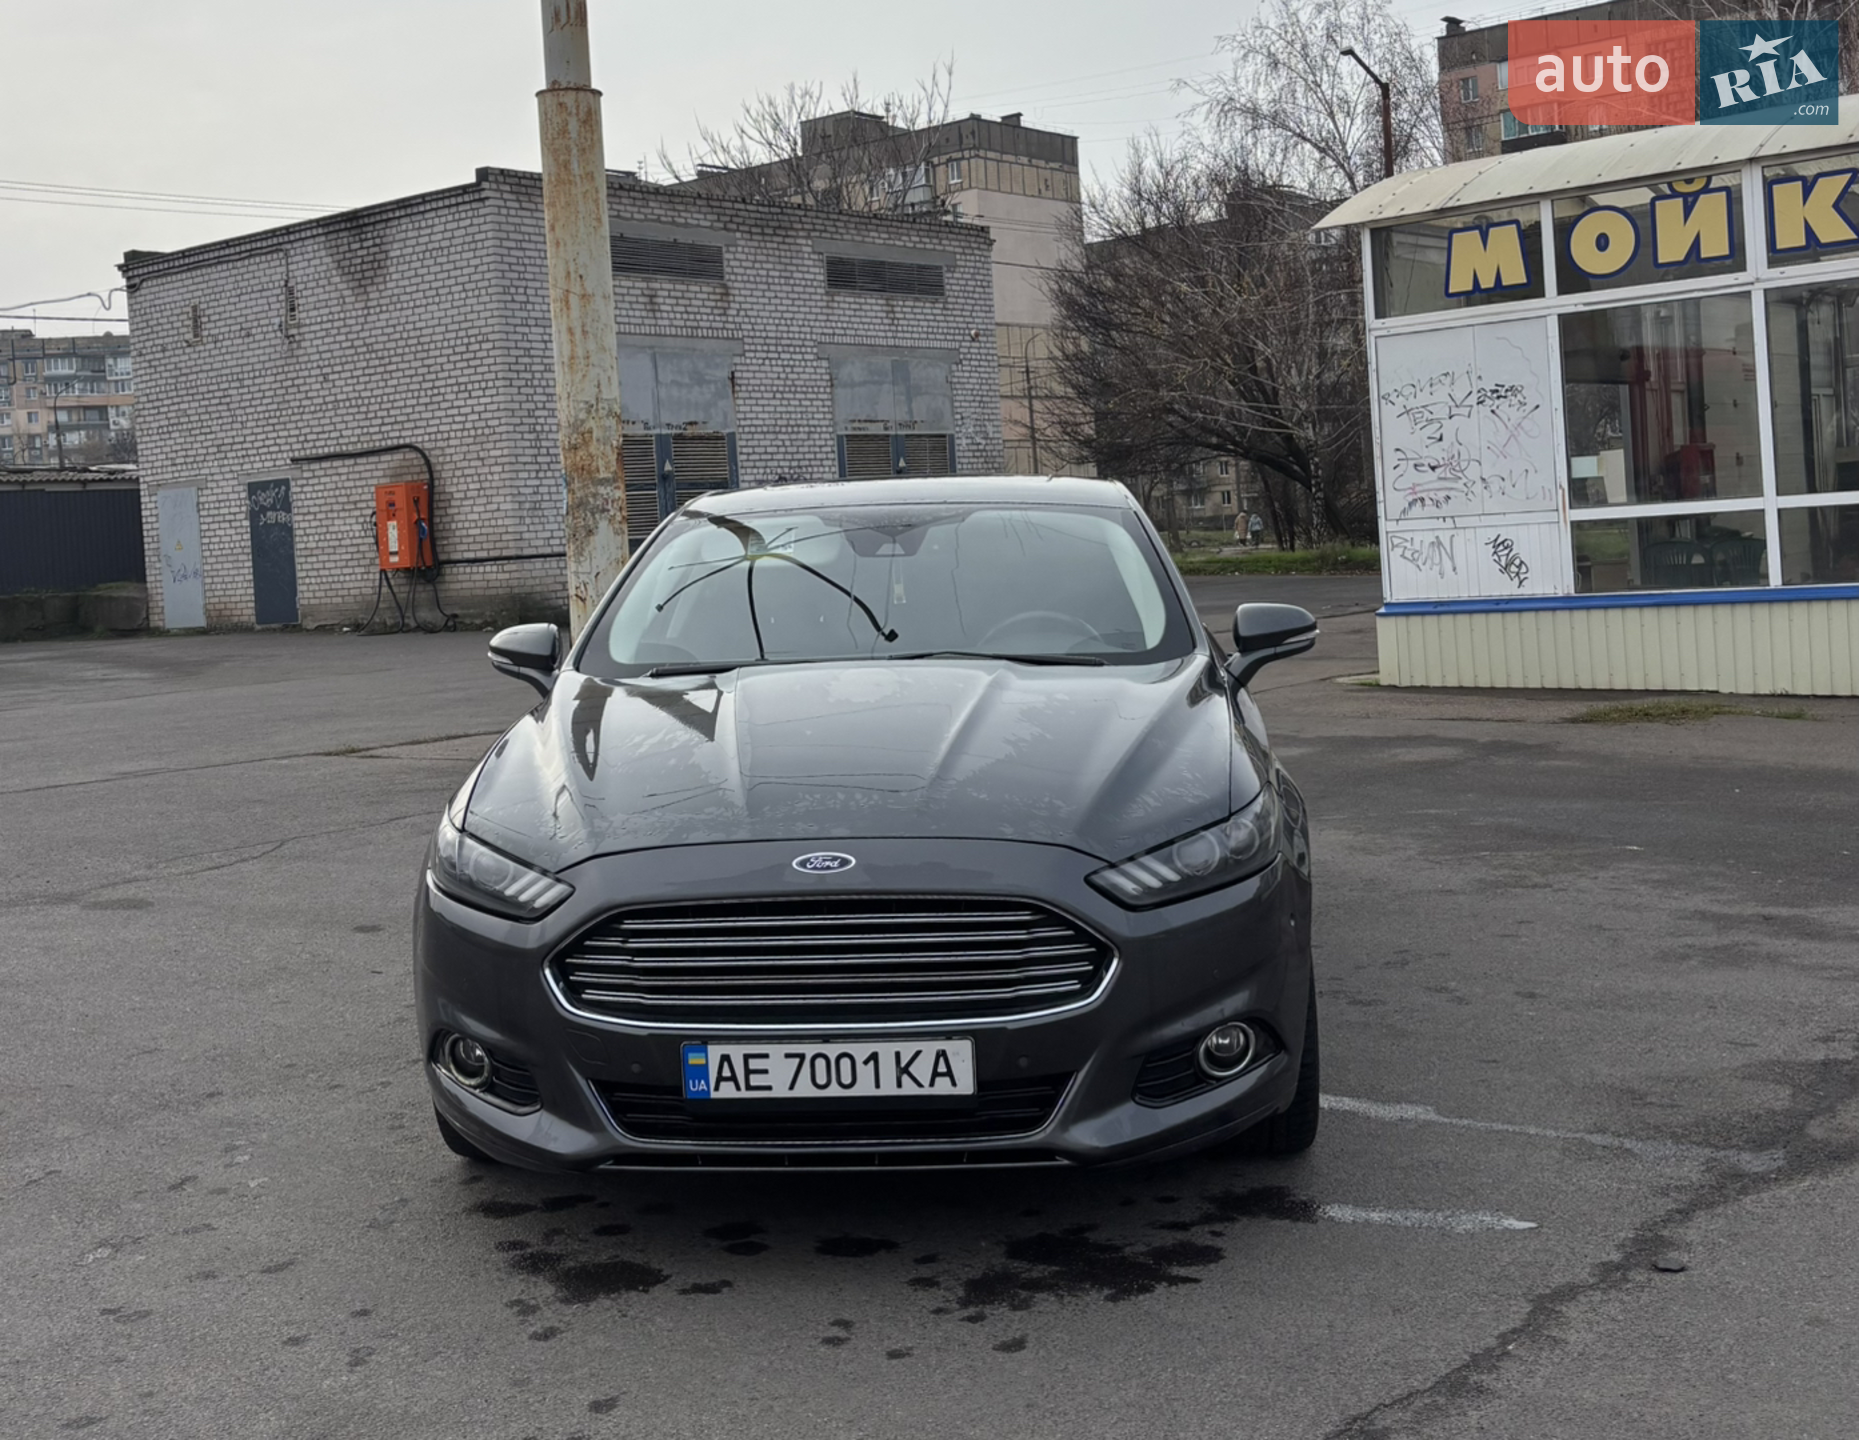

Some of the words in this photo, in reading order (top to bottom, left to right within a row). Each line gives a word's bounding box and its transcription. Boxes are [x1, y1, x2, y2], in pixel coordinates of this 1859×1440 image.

[806, 856, 842, 869] Ford
[713, 1052, 773, 1092] AE
[784, 1051, 881, 1090] 7001
[894, 1048, 958, 1089] KA
[689, 1079, 708, 1092] UA
